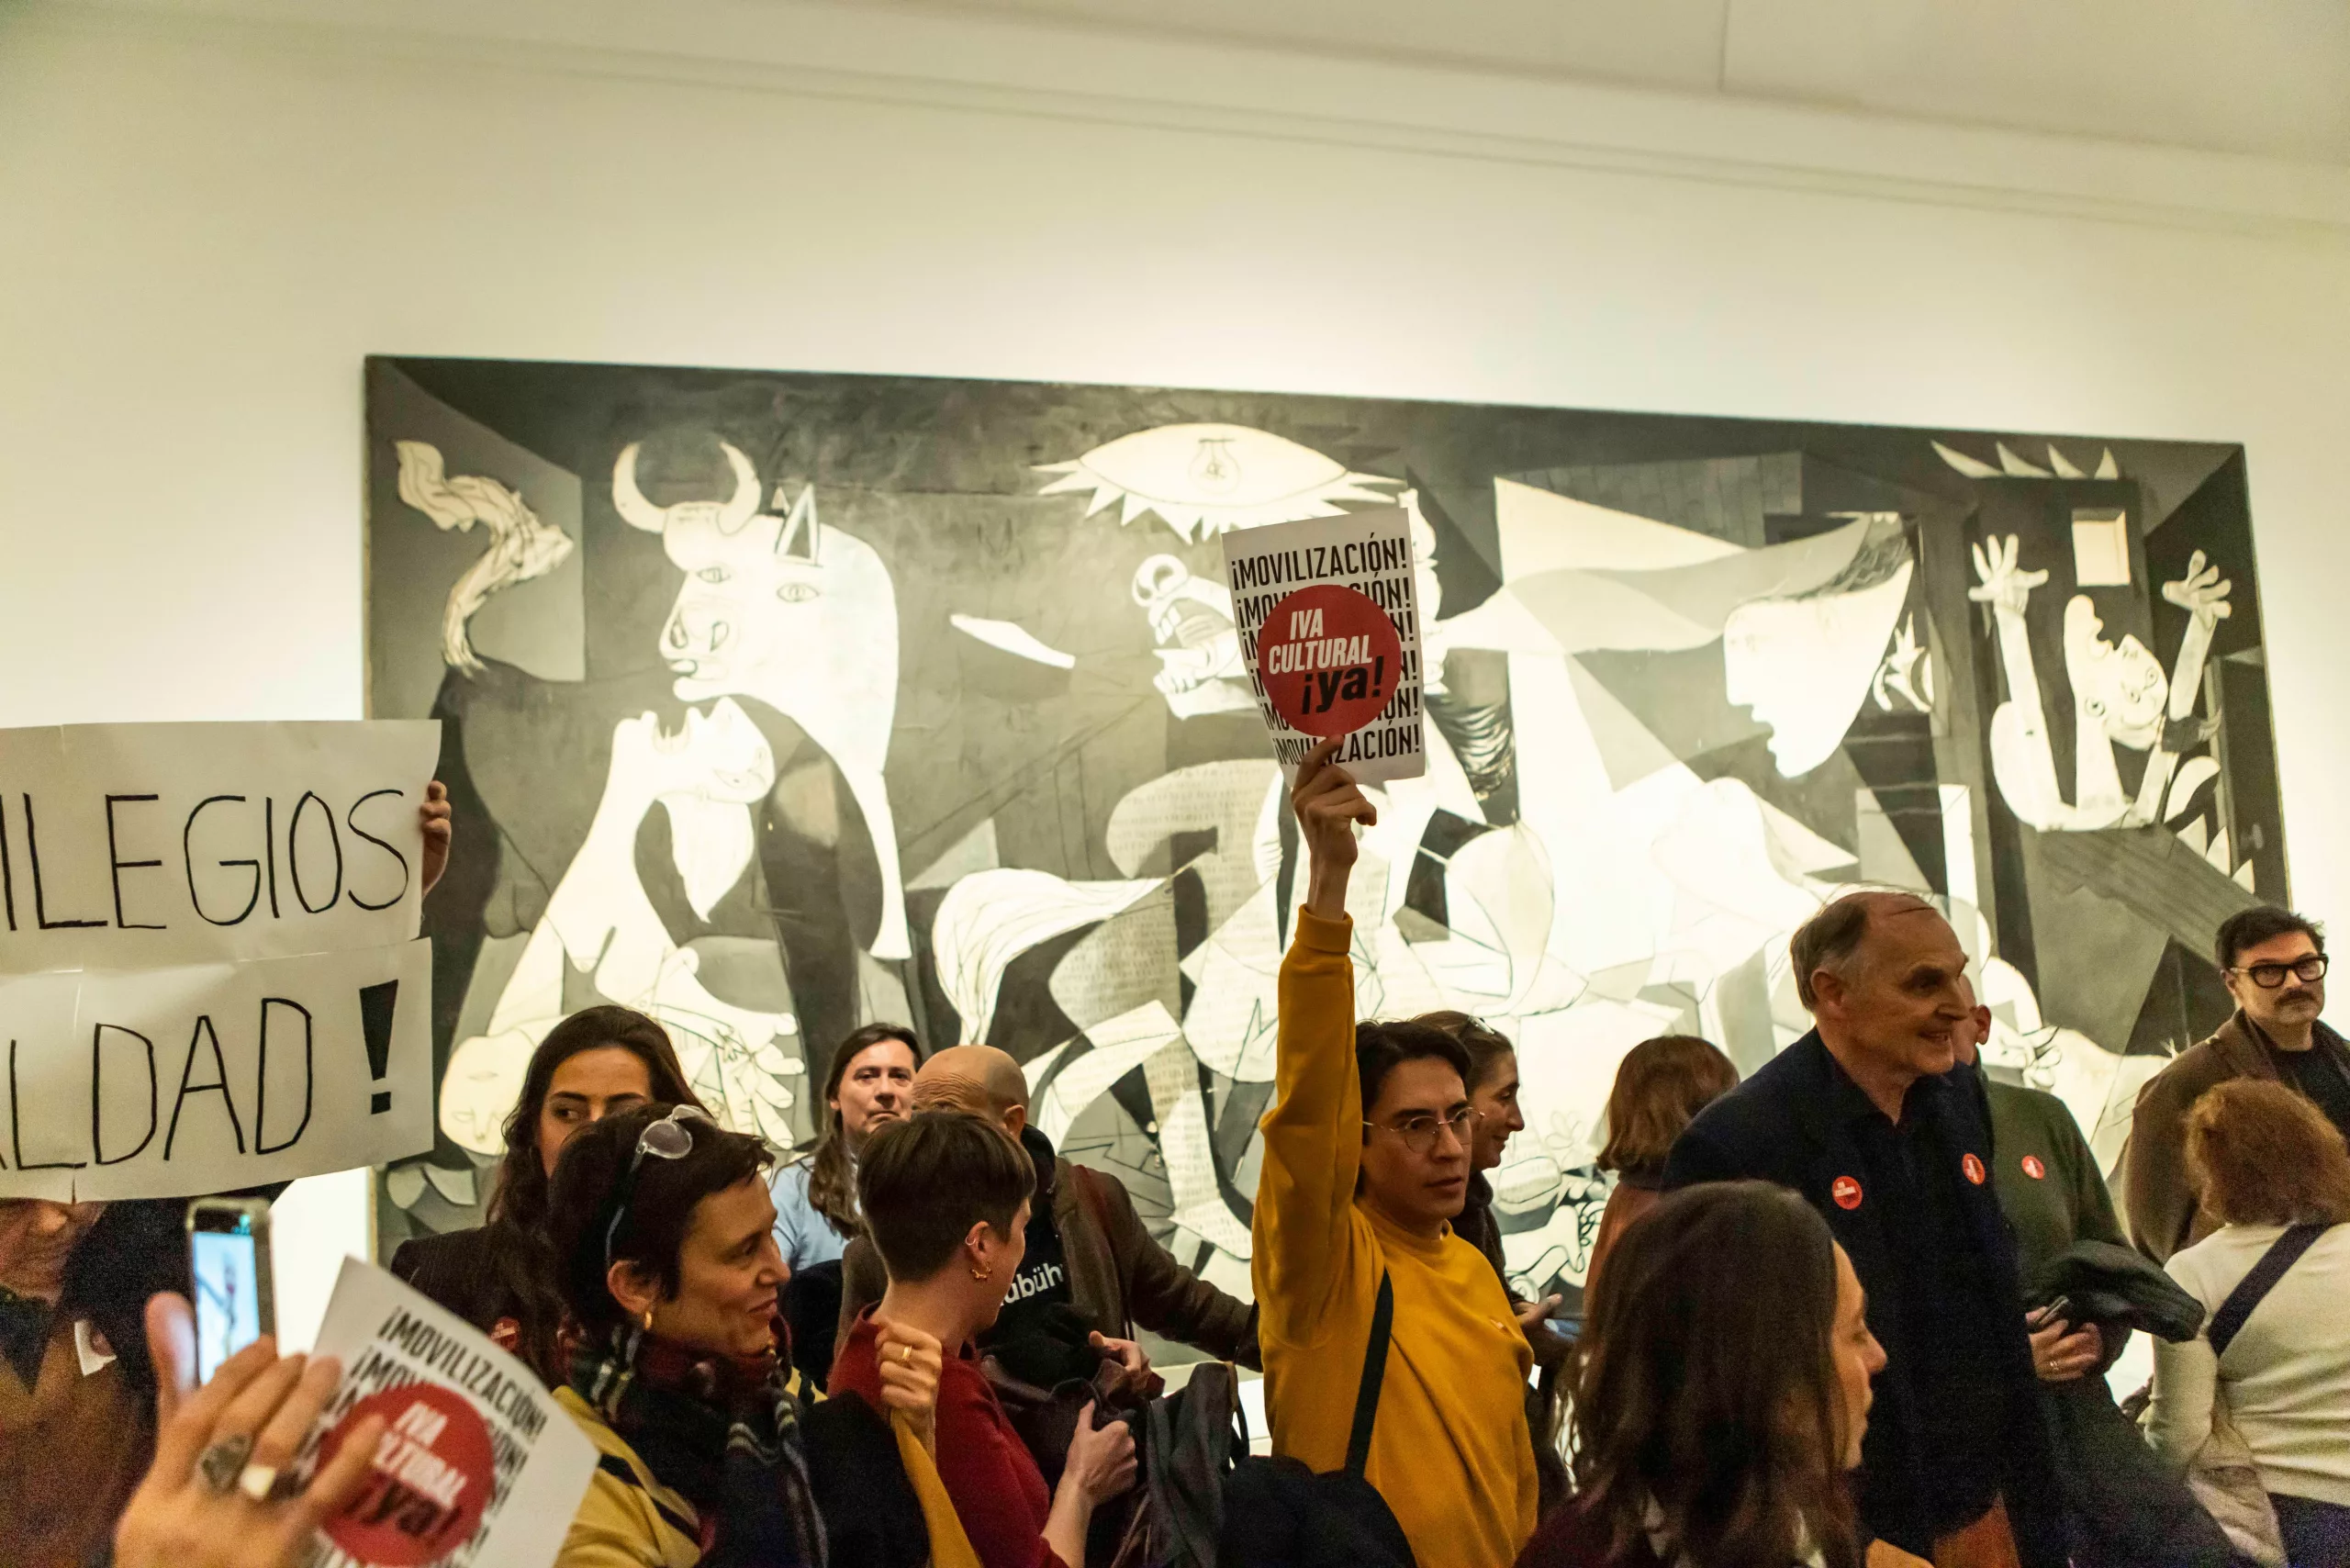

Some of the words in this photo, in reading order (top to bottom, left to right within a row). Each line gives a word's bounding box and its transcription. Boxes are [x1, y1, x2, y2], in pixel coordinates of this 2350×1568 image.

[1231, 532, 1407, 591] ¡MOVILIZACIÓN!
[1290, 608, 1324, 641] IVA
[1269, 634, 1373, 675] CULTURAL
[1302, 655, 1384, 715] ¡ya!
[0, 997, 313, 1171] LDAD
